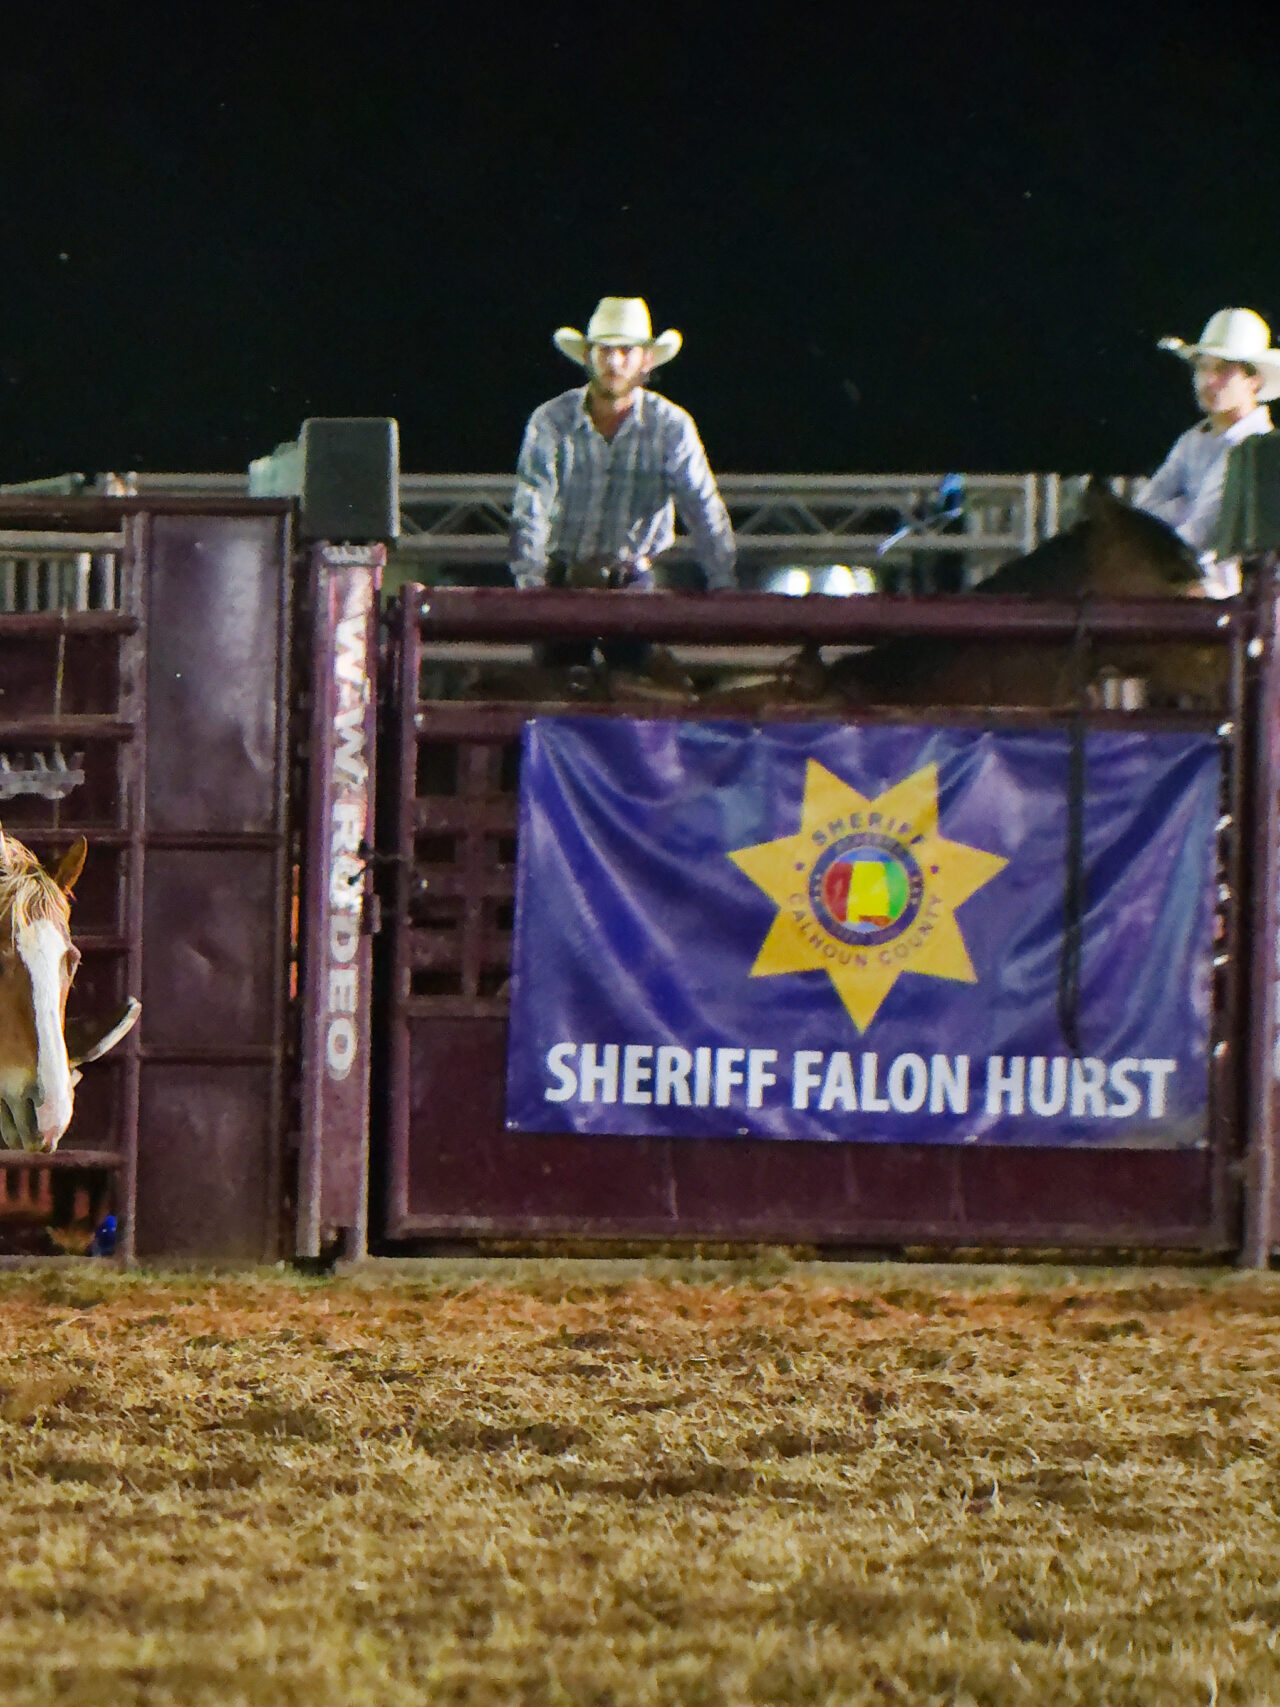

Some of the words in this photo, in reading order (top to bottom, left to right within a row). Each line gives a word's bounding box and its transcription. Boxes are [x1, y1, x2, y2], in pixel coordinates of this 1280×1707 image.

[811, 811, 926, 847] SHERIFF
[327, 802, 367, 1074] RODEO
[545, 1043, 778, 1108] SHERIFF
[793, 1051, 969, 1114] FALON
[985, 1056, 1177, 1118] HURST
